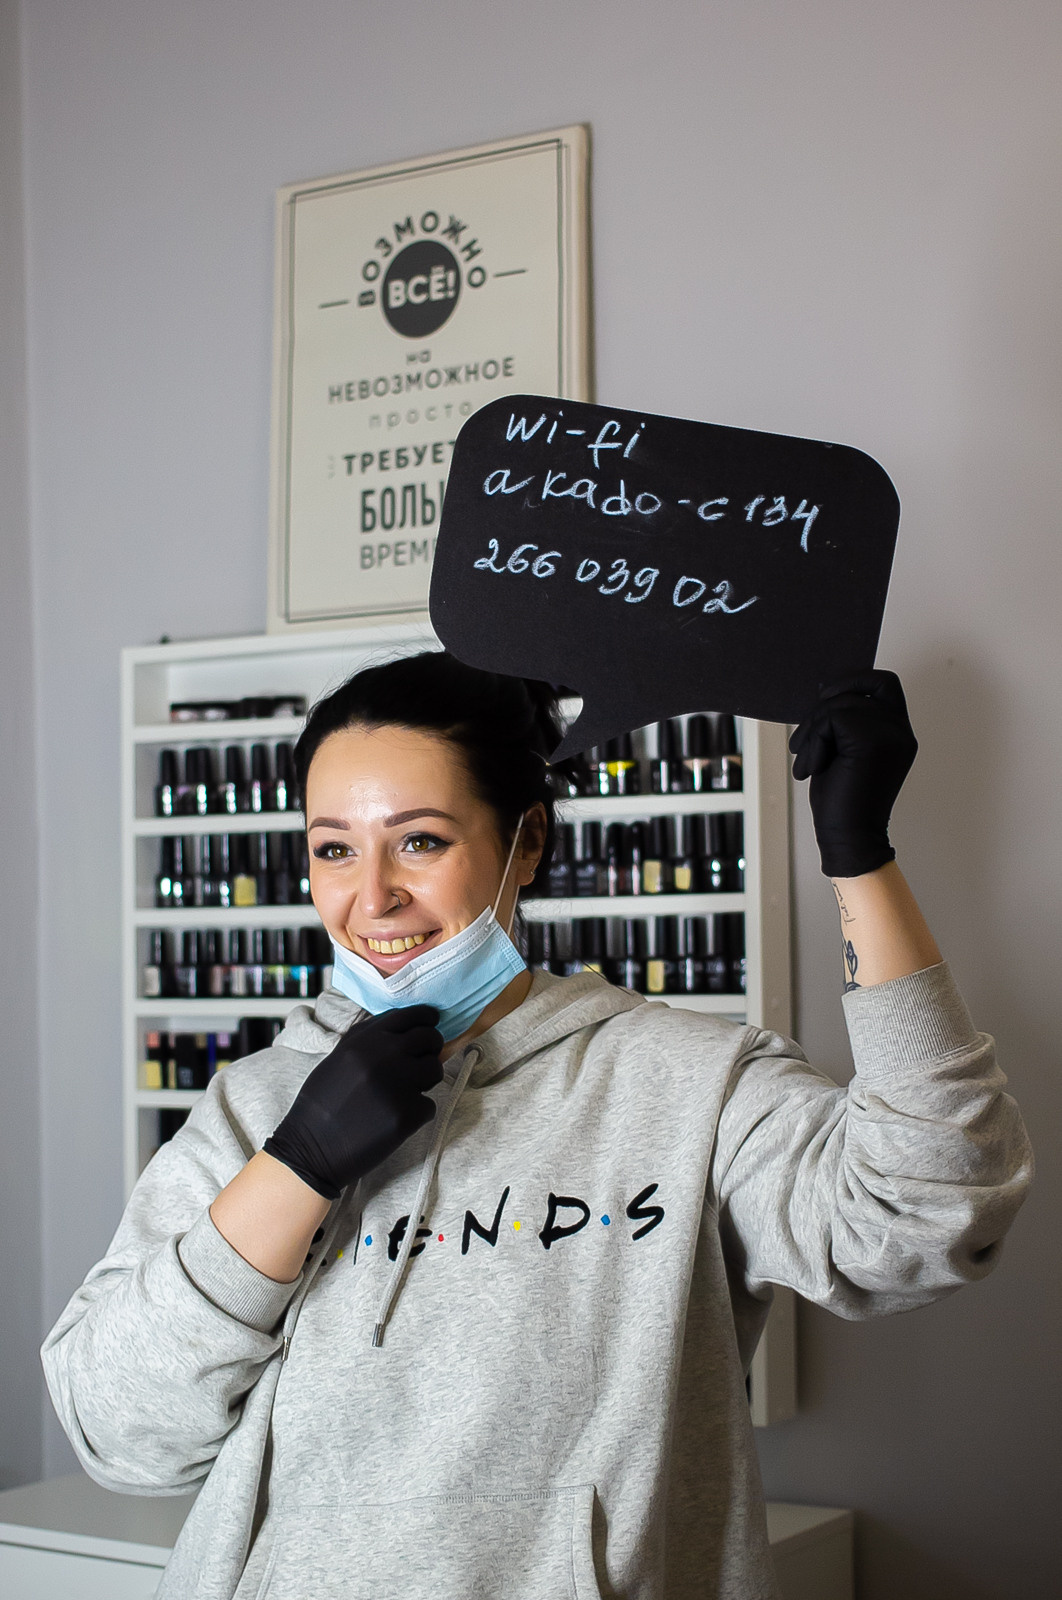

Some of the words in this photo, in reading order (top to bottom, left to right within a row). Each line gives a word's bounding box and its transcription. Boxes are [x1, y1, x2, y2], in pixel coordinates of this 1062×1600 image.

[357, 210, 488, 308] ВОЗМОЖНО
[387, 266, 456, 309] ВСЁ!
[327, 356, 516, 404] НЕВОЗМОЖНОЕ
[368, 401, 473, 431] просто
[360, 480, 445, 534] БОЛЬ
[360, 538, 437, 570] ВРЕМ
[474, 537, 562, 580] 266
[574, 558, 661, 605] 039
[672, 575, 758, 615] 02
